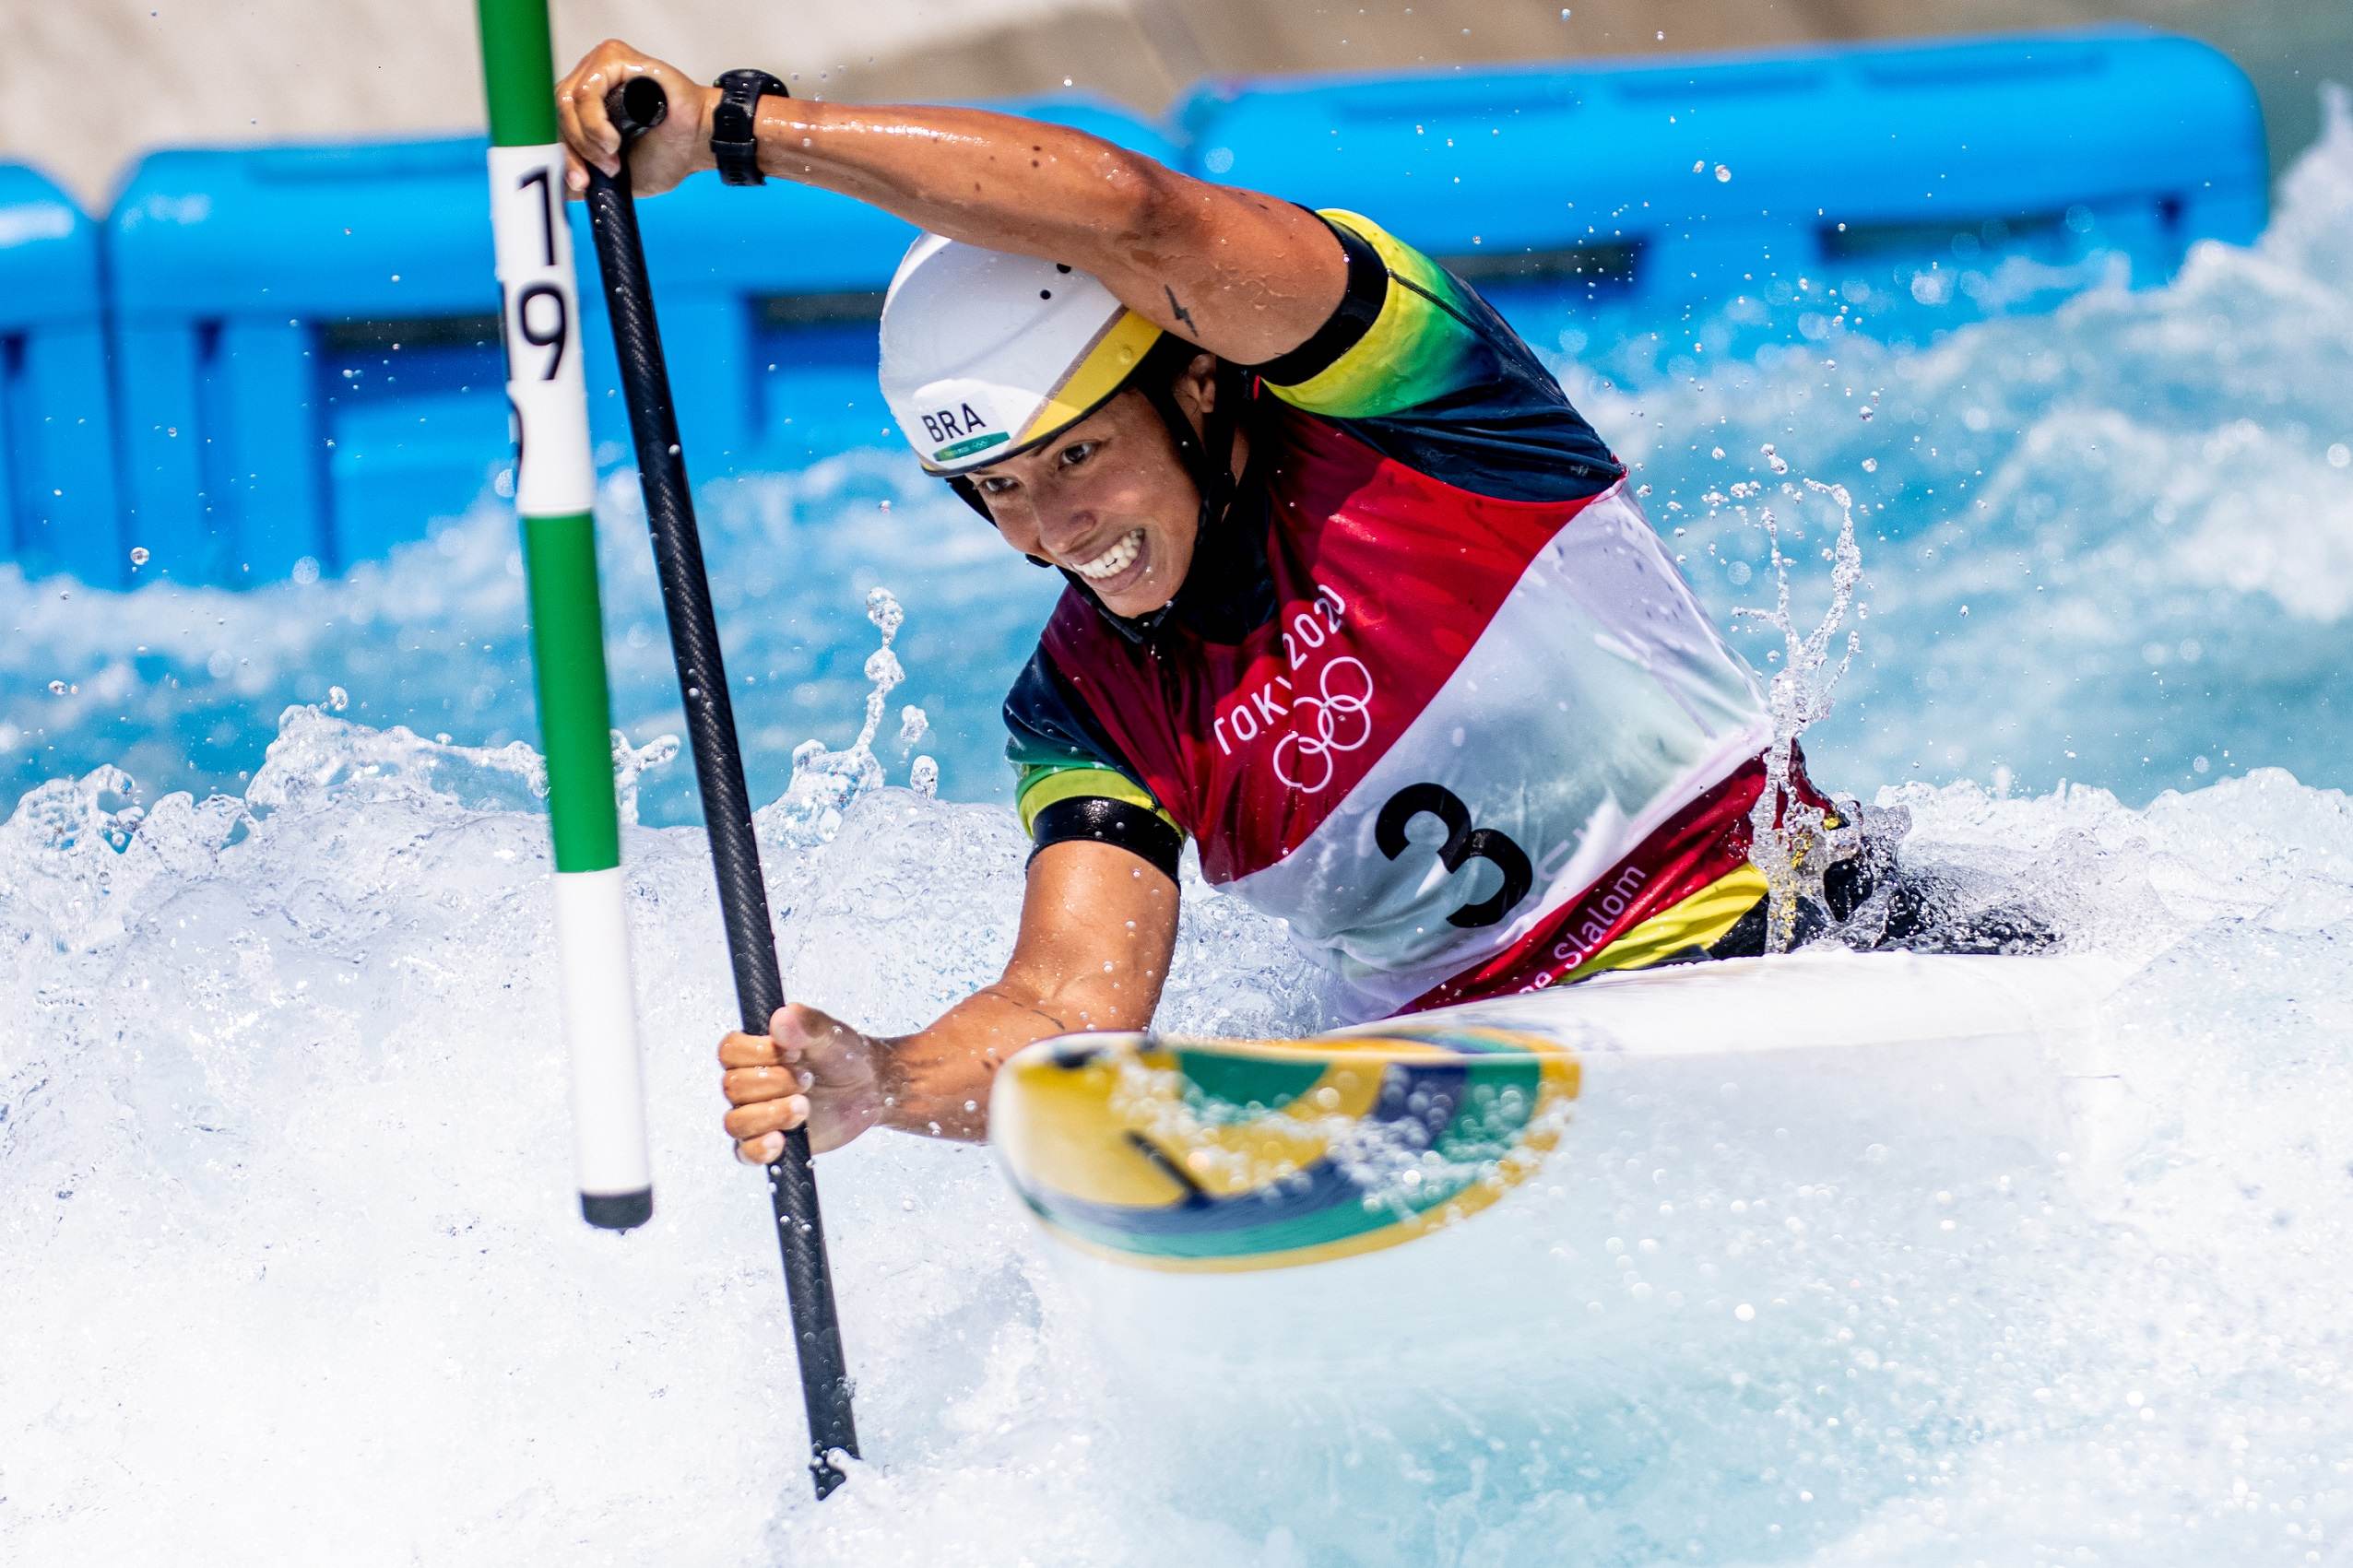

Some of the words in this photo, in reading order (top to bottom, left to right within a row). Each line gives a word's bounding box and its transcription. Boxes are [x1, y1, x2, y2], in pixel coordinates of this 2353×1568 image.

[517, 164, 566, 382] 19
[921, 402, 987, 443] BRA
[1213, 675, 1293, 755] TOK
[1375, 781, 1533, 928] 3
[1554, 866, 1647, 970] Slalom
